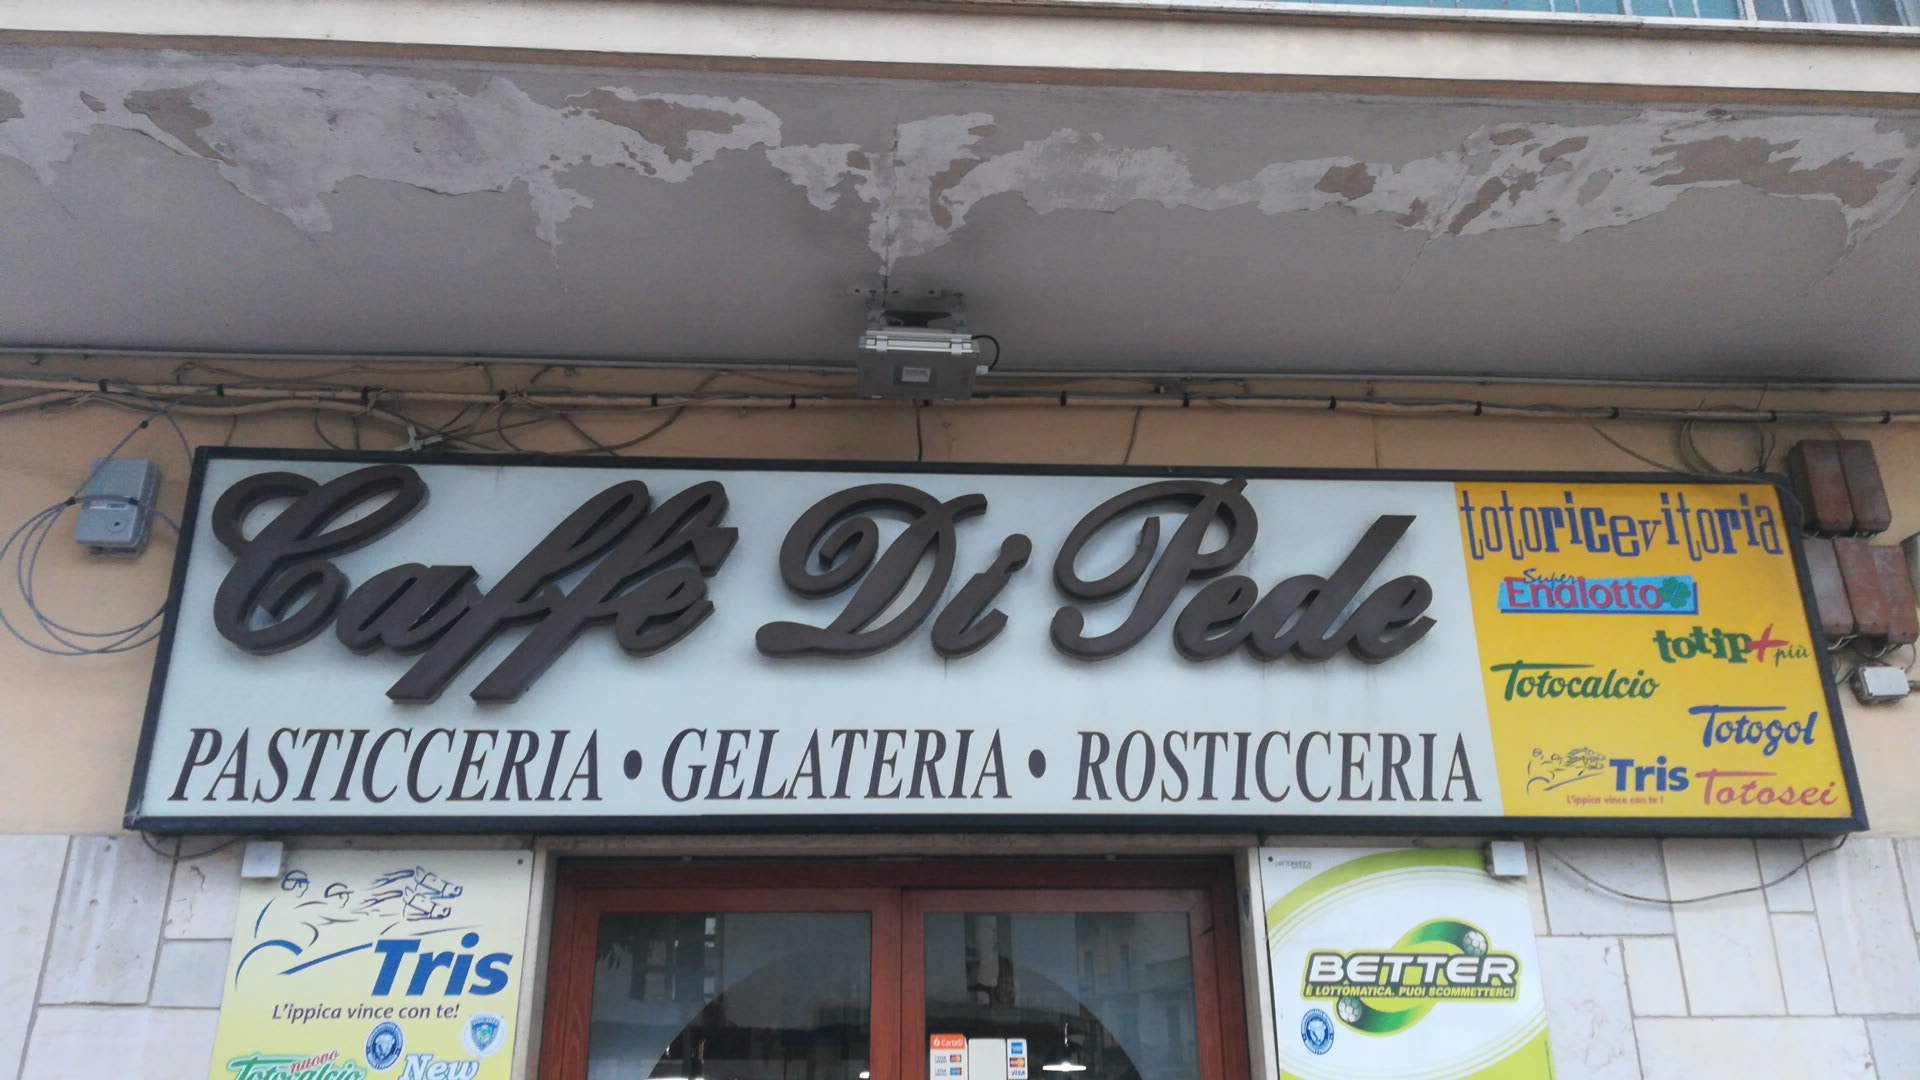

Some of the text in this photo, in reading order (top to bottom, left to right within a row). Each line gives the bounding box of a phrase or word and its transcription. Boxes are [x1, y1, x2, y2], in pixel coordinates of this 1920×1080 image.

[1460, 490, 1783, 561] totoricevitoria
[755, 482, 1032, 657] Di
[1050, 477, 1438, 663] Pede
[1504, 576, 1664, 609] Enalotto
[1490, 660, 1660, 701] Totocalcio
[1688, 705, 1817, 756] Totogol
[167, 727, 1483, 804] PASTICCERIA GELATERIA ROSTICCERIA
[1609, 756, 1689, 792] Tris
[1694, 769, 1838, 806] Totosei
[371, 932, 513, 996] Tris
[1309, 955, 1517, 984] BETTER
[1400, 986, 1425, 997] PUOI
[1429, 986, 1515, 998] SCOMMETTERCI
[272, 1003, 460, 1025] L'ippica vince con te!
[289, 1050, 339, 1073] nuovo
[400, 1054, 479, 1080] New
